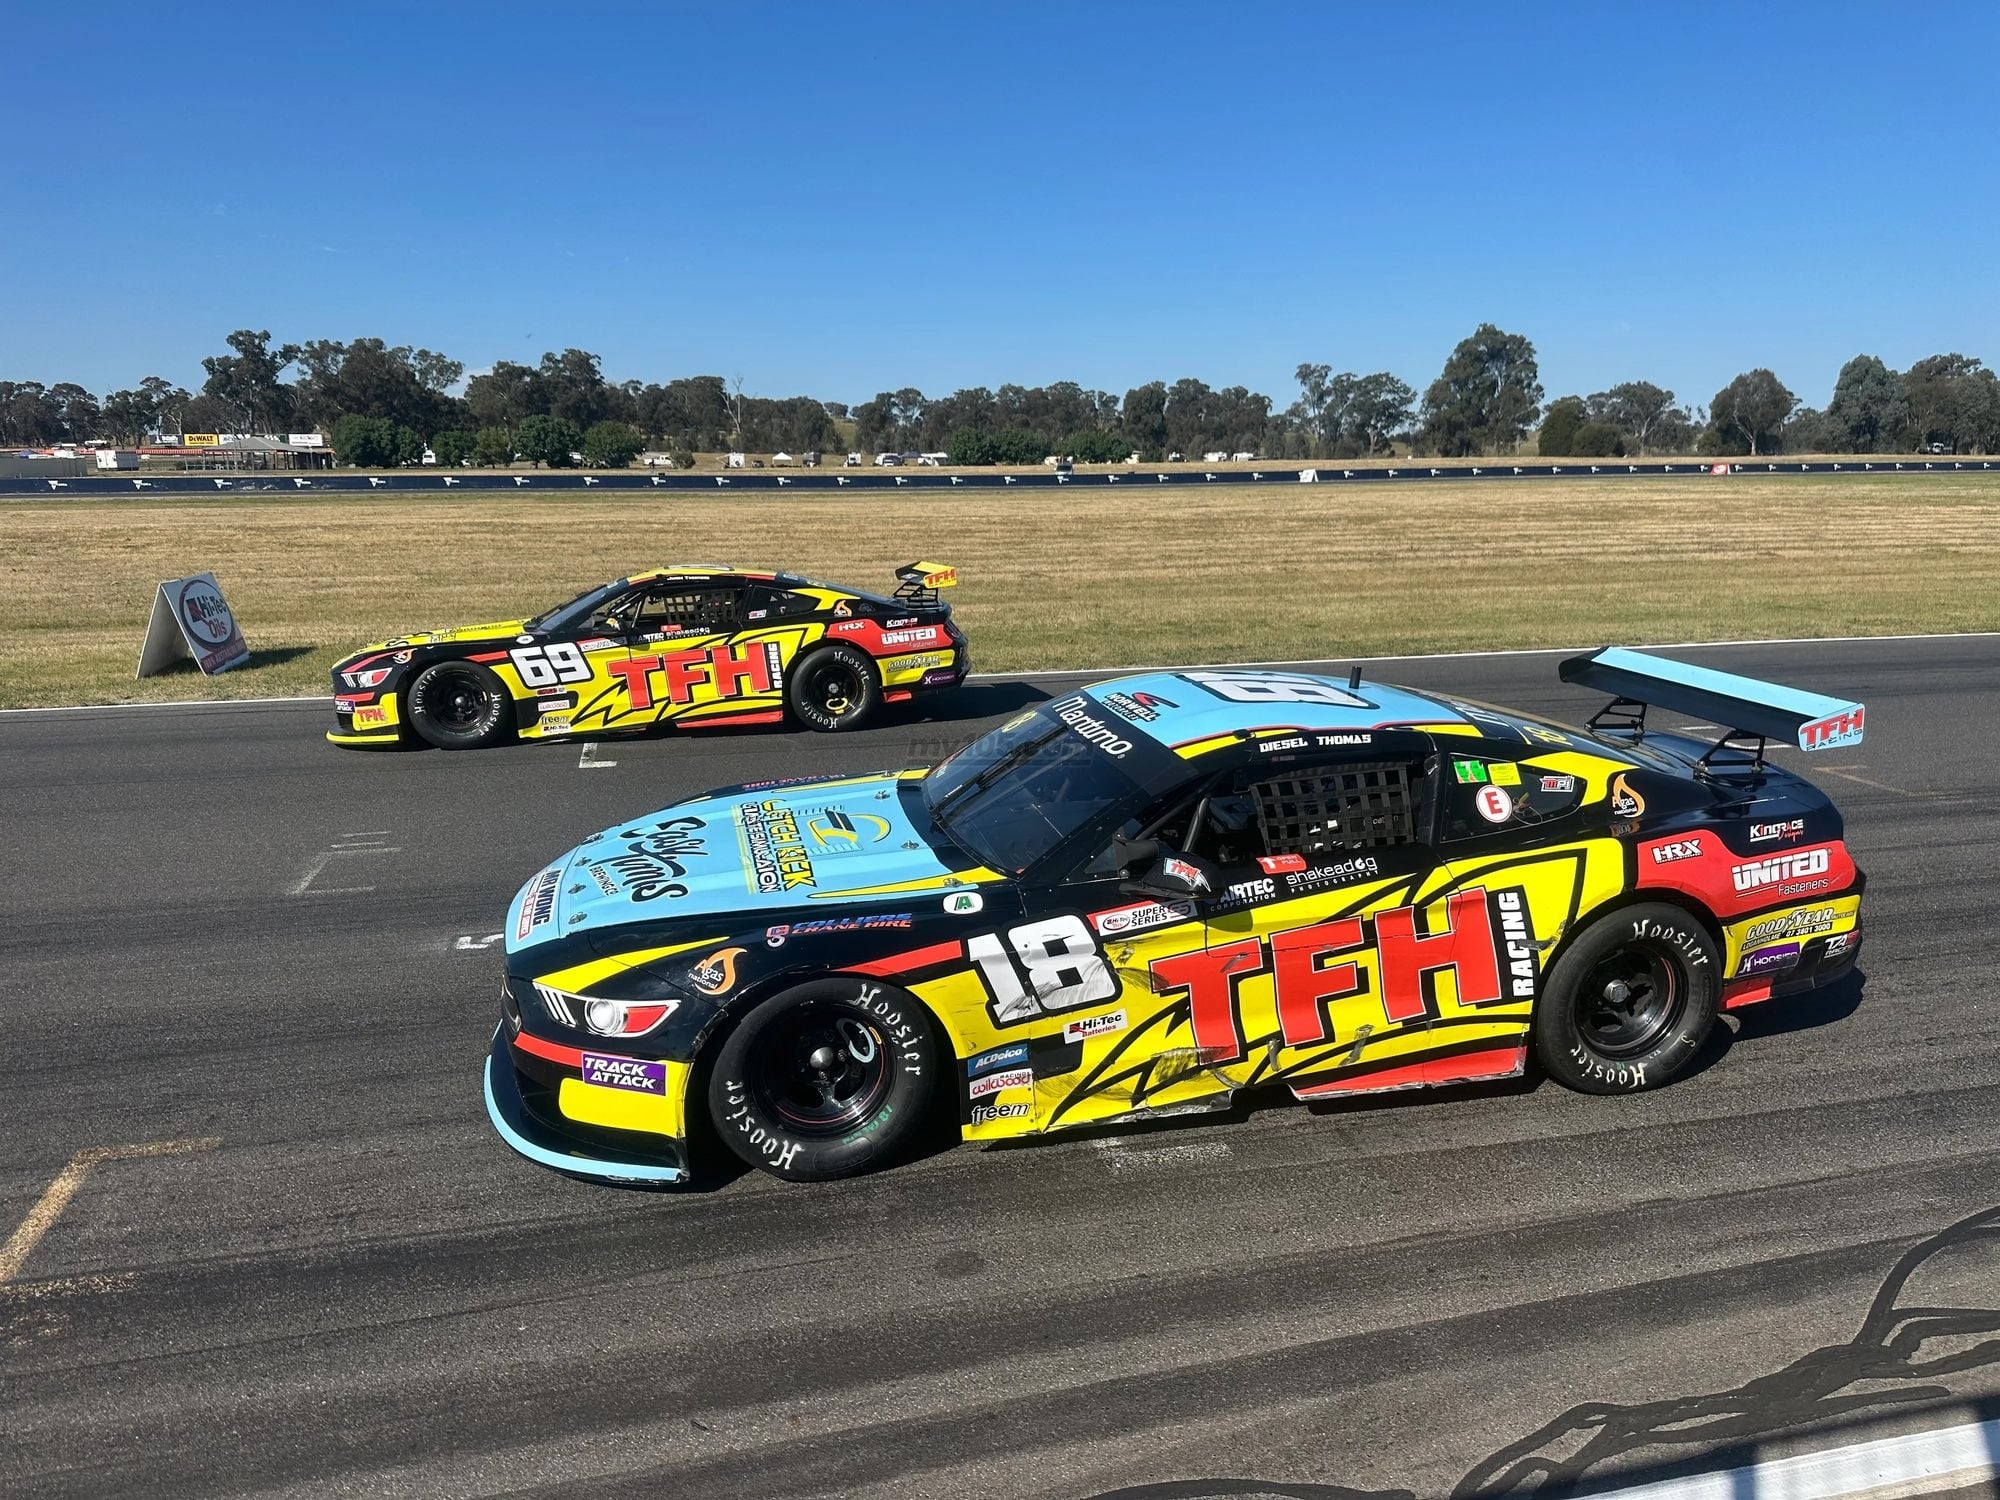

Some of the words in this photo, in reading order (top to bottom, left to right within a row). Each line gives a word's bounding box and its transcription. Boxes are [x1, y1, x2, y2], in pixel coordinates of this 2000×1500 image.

[207, 618, 228, 638] Oils
[880, 627, 937, 645] UNITED
[509, 642, 592, 687] 69
[606, 640, 771, 710] TFH
[768, 643, 783, 688] RACING
[834, 650, 871, 682] Hoosier
[413, 669, 440, 715] Hoosier
[1801, 707, 1864, 745] TFH
[1259, 737, 1308, 753] DIESEL
[1315, 733, 1372, 746] THOMAS
[1484, 791, 1503, 815] E
[1652, 839, 1702, 862] HRX
[1290, 870, 1379, 893] PHOTOGRAPHY
[1731, 848, 1829, 891] UNITED
[1221, 877, 1275, 903] AIRTEC
[1777, 877, 1829, 896] Fasteners
[1131, 905, 1166, 919] SUPER
[1131, 912, 1168, 928] SERIES
[791, 923, 864, 935] CRANE
[864, 919, 913, 929] HIRE
[1497, 892, 1534, 997] RACING
[1632, 918, 1709, 967] Hoosier
[687, 971, 719, 991] national
[967, 914, 1117, 1024] 18
[1149, 886, 1502, 1065] TFH
[850, 982, 924, 1077] Hoosier
[1081, 1023, 1117, 1038] Batteries
[1082, 1013, 1122, 1031] Hi-Tec
[584, 1057, 648, 1077] TRACK
[975, 1048, 1026, 1069] ACDelco
[1570, 1043, 1649, 1089] Hoosier
[589, 1071, 656, 1090] ATTACK
[972, 1076, 1030, 1096] wilwood
[725, 1079, 806, 1170] Hoosier
[971, 1103, 1030, 1127] freem
